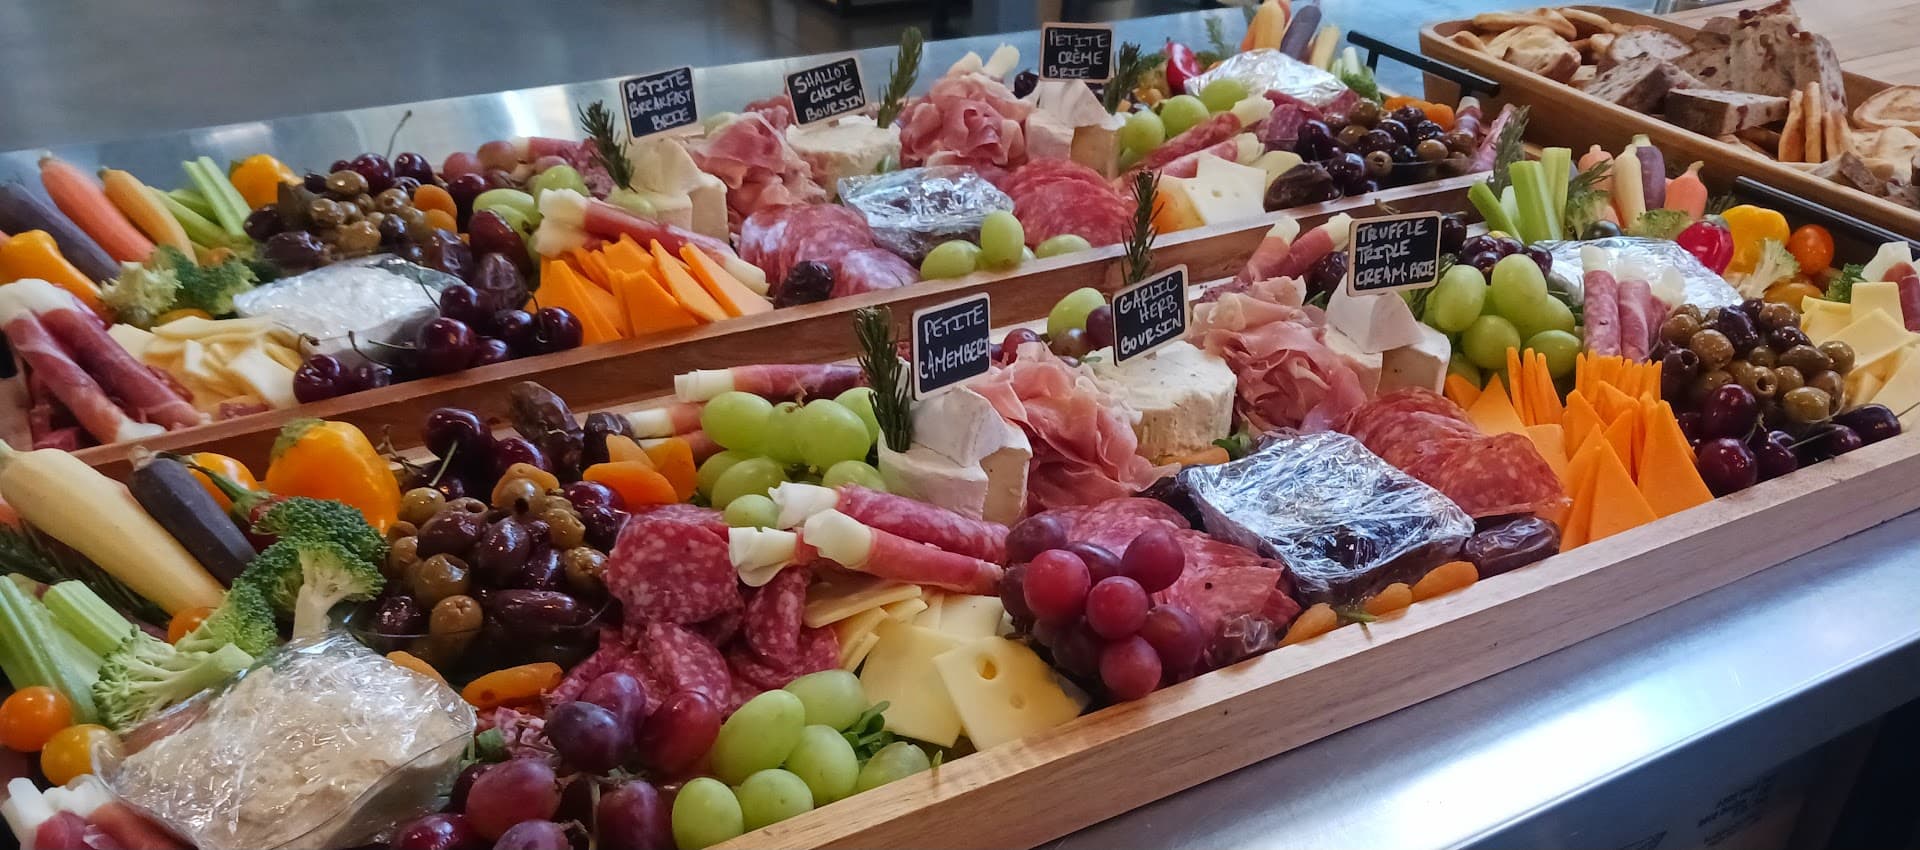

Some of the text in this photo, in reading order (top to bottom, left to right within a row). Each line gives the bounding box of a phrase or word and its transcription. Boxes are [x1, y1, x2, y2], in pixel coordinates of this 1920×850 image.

[1049, 29, 1109, 48] PETITE
[627, 70, 689, 99] PETITE
[794, 63, 848, 94] SHALLOT
[1048, 65, 1090, 79] BRIE
[629, 89, 692, 118] BREAKFAST
[810, 78, 855, 103] CHIVE
[651, 107, 691, 130] BRIE
[1357, 219, 1428, 243] TRUFFLE
[1357, 239, 1411, 265] TRIPLE
[1120, 276, 1178, 314] GARLIC
[1139, 294, 1178, 323] HERB
[924, 303, 985, 345] PETITE
[1120, 308, 1182, 354] BOURSIN
[920, 336, 989, 379] CAMEMBERT
